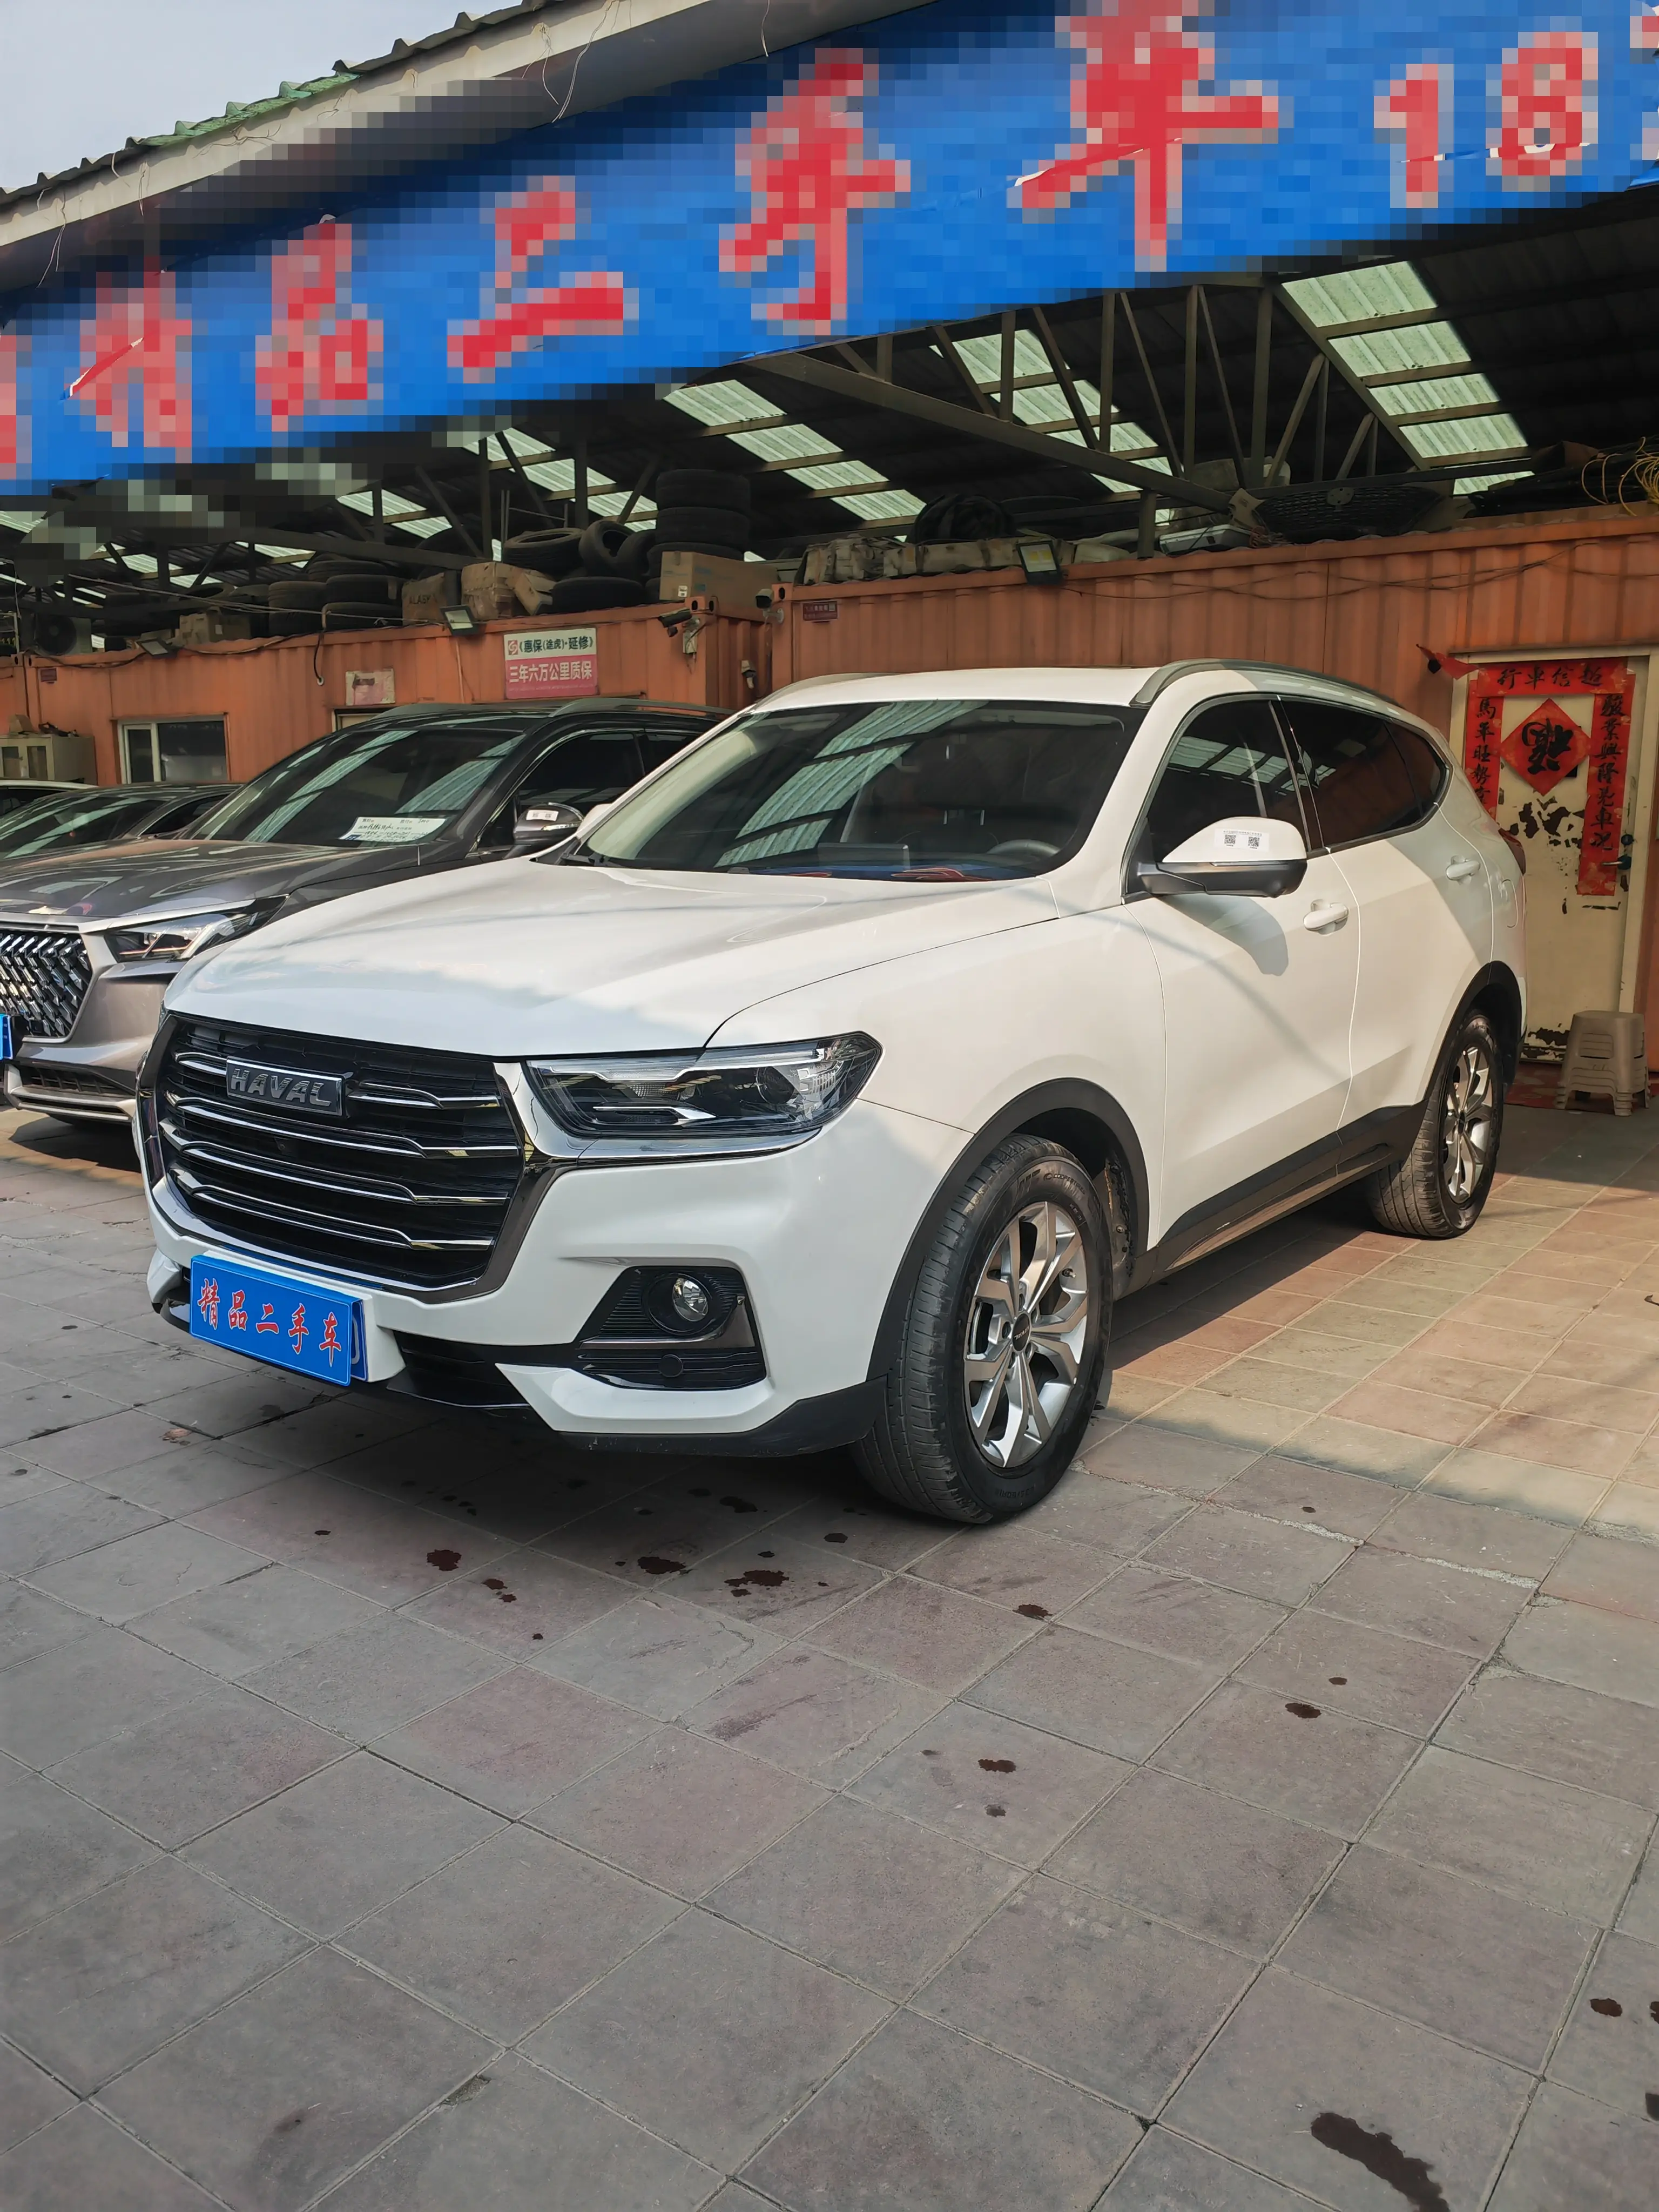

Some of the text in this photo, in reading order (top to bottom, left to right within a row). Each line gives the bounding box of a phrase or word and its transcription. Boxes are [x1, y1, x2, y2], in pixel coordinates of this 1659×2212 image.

[509, 660, 592, 683] 三年六万公里质保
[1521, 718, 1574, 775] 福
[231, 1068, 332, 1107] HAVAL
[197, 1278, 342, 1368] 精品二手车
